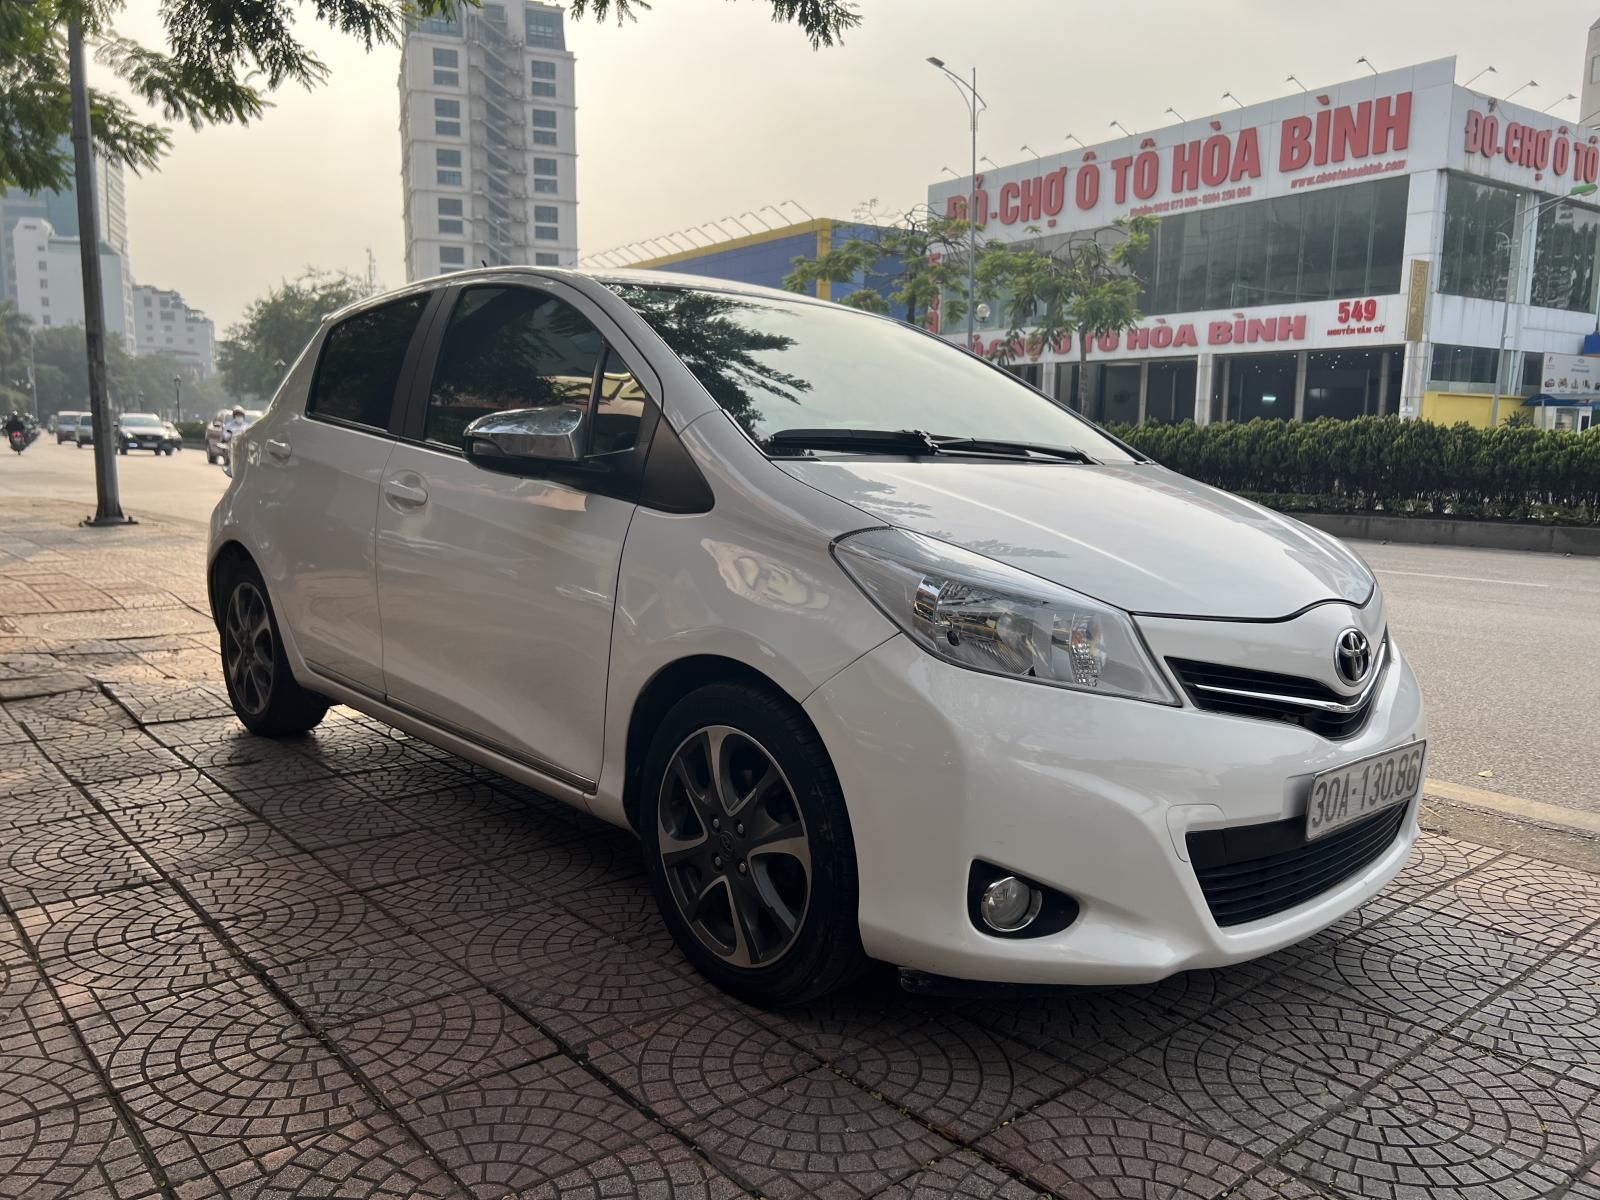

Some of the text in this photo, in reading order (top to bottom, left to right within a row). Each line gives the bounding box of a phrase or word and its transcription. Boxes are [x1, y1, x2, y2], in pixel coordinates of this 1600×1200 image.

[1076, 151, 1100, 210] Ô
[1111, 138, 1159, 204] TÔ
[1171, 121, 1262, 193] HÒA
[1279, 92, 1412, 172] BÌNH
[1574, 135, 1599, 184] TÔ
[1127, 319, 1198, 350] HÒA
[1208, 313, 1306, 345] BÌNH
[1338, 299, 1376, 324] 549
[1312, 750, 1420, 828] 30A-130.86
